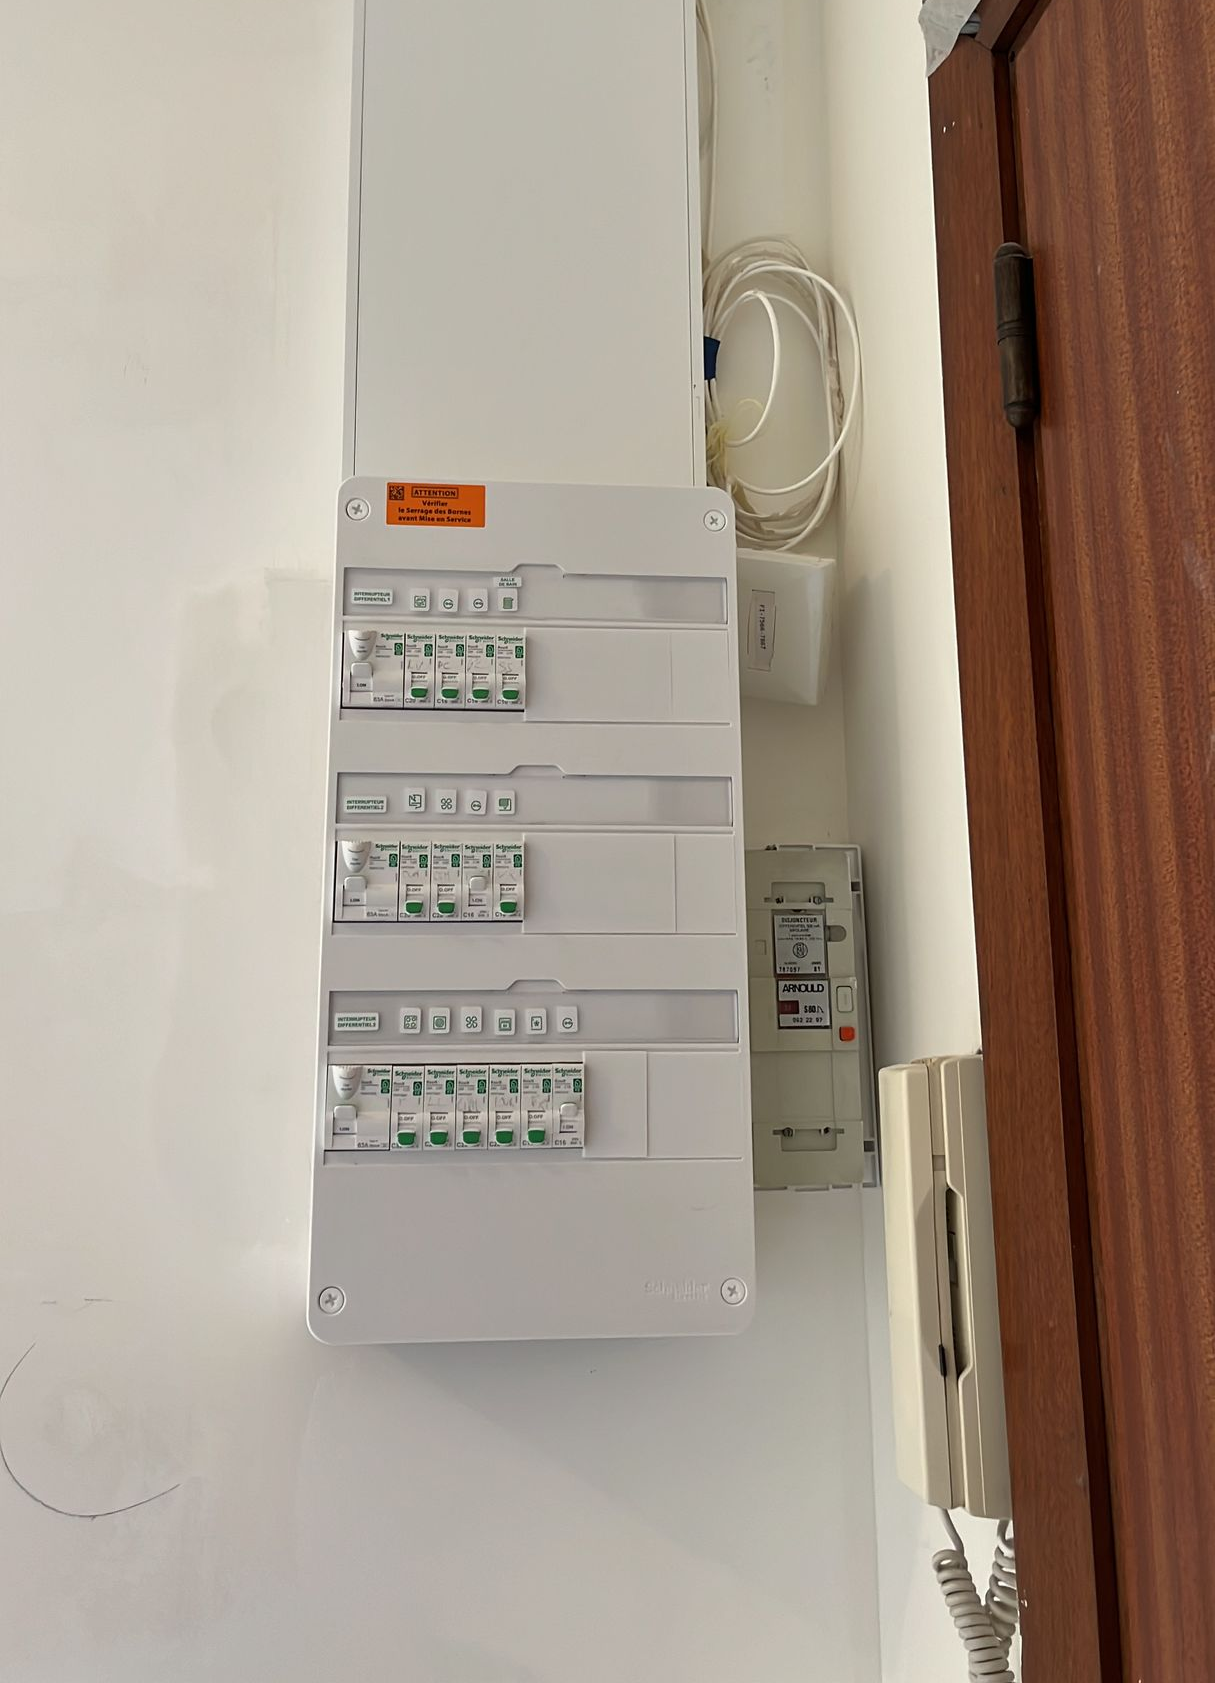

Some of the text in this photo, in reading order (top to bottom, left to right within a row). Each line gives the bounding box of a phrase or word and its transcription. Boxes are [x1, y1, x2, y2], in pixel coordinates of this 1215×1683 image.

[414, 489, 456, 497] ATTENTION
[406, 507, 433, 515] Serrage
[402, 844, 428, 853] Schneider
[434, 844, 460, 852] Schneider
[465, 844, 491, 853] Schneider
[496, 844, 522, 852] Schneider
[782, 983, 824, 993] ARNOULD
[368, 1068, 390, 1076] Schneider
[395, 1070, 422, 1080] Schneider
[428, 1069, 455, 1078] Schneider
[459, 1069, 486, 1078] Schneider
[492, 1068, 518, 1077] Schneider
[524, 1068, 551, 1077] Schneider
[555, 1068, 582, 1077] Schneider
